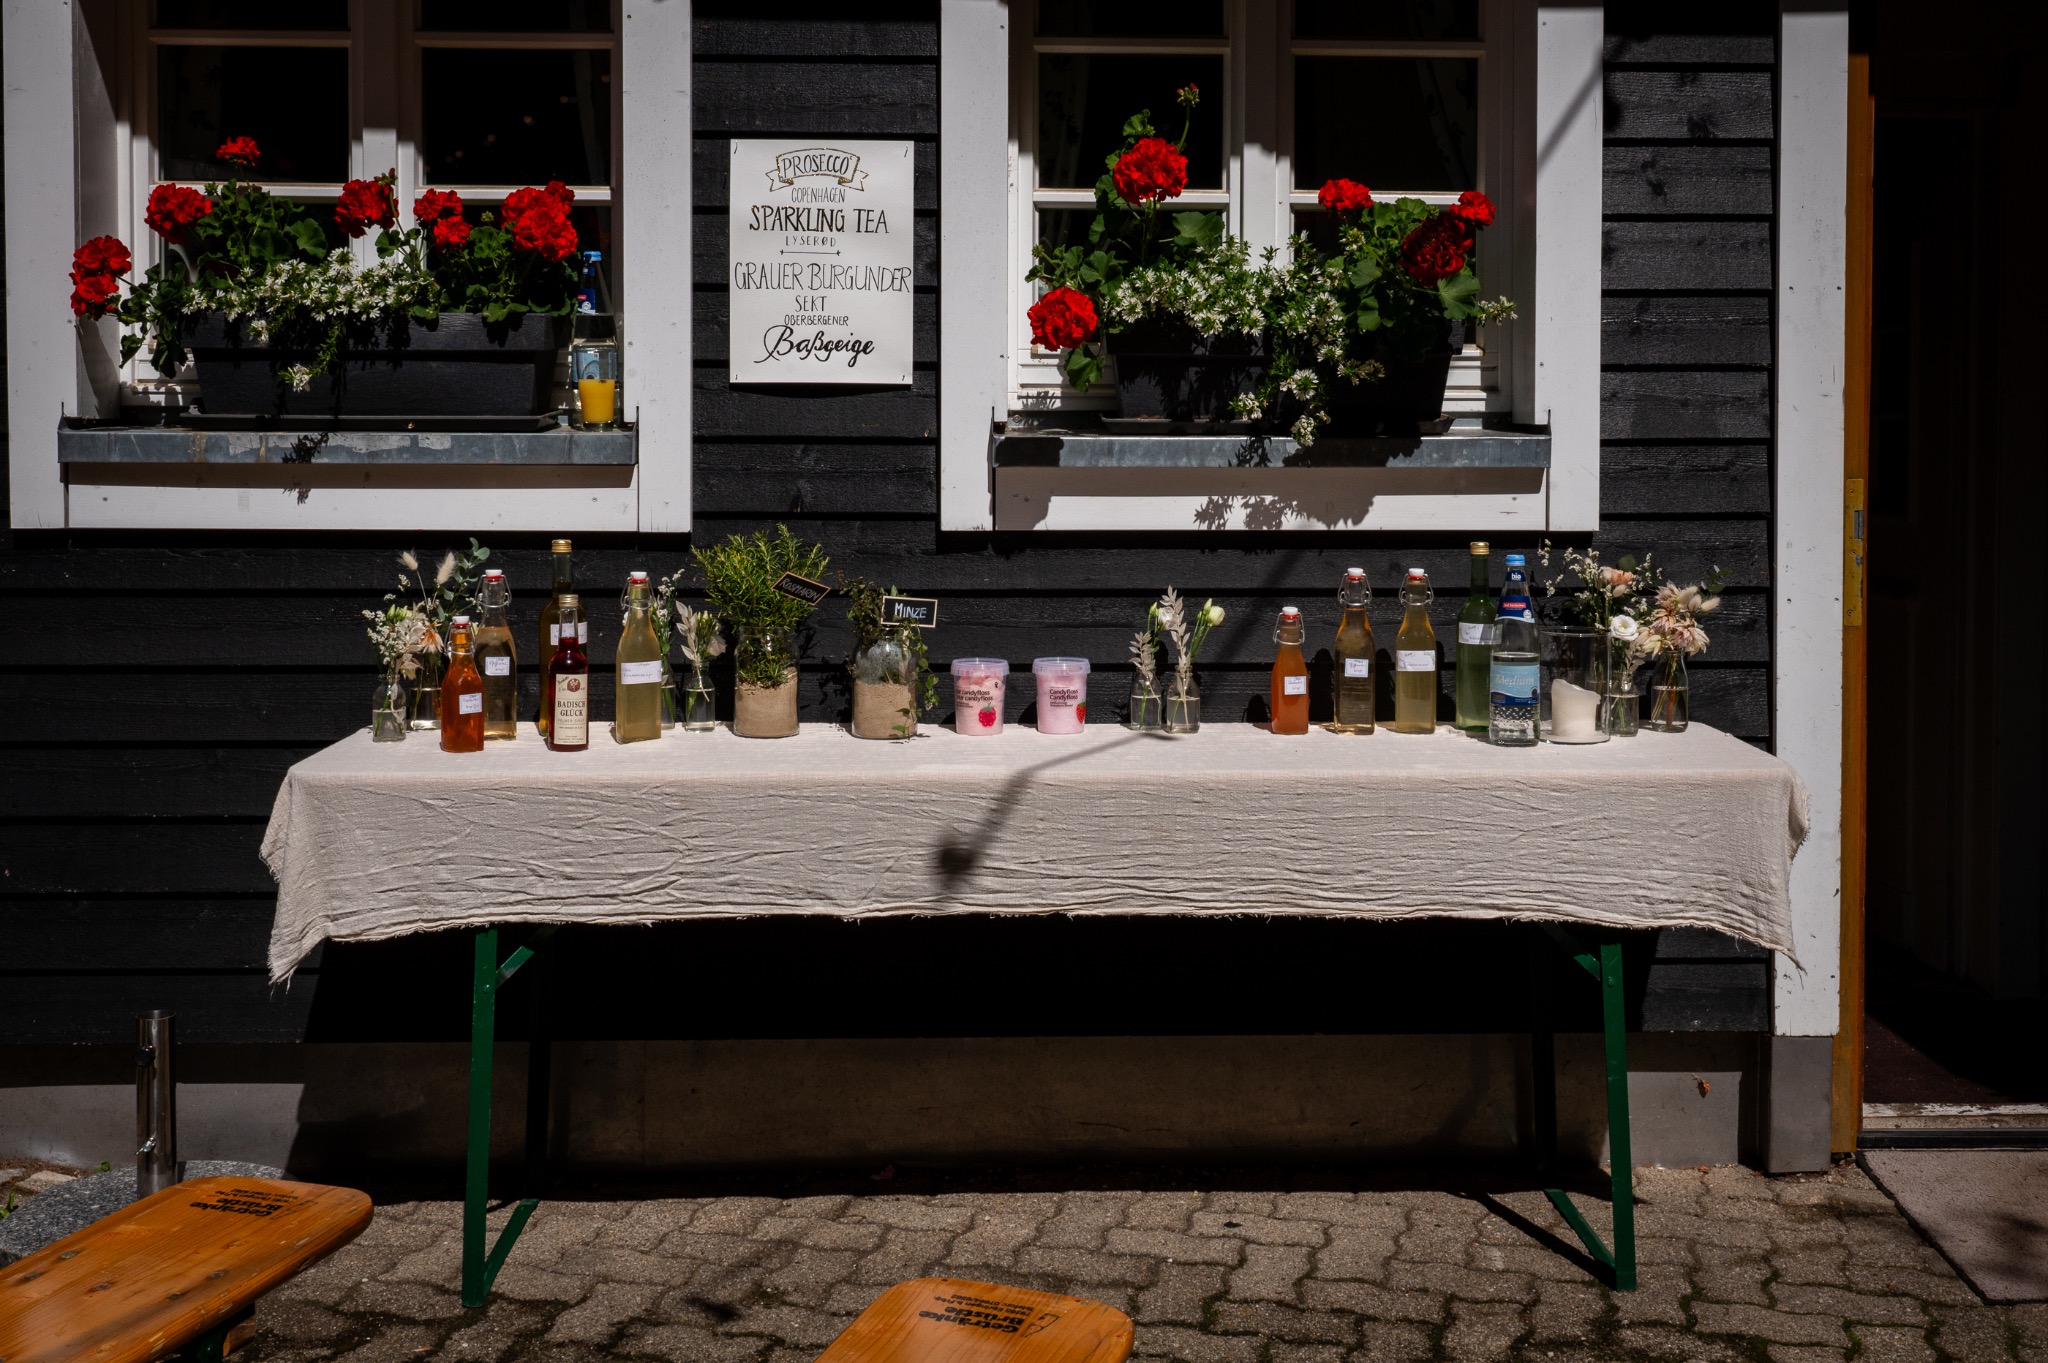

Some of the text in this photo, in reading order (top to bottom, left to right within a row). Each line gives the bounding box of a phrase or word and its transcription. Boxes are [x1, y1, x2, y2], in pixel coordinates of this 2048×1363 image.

[781, 154, 852, 178] PROSECCO
[791, 187, 846, 204] COPENHAGEN
[749, 205, 889, 233] SPARKLING TEA
[785, 235, 837, 247] LYSERØD
[734, 261, 912, 293] GRAUER BURGUNDER
[795, 295, 827, 312] SEKT
[784, 314, 849, 326] OBERBERGENER
[753, 324, 875, 368] Baßgeige
[1511, 572, 1522, 581] bio
[779, 577, 820, 601] ROSMARIN
[894, 601, 927, 619] MINZE
[1495, 674, 1535, 686] Medium
[962, 689, 990, 697] candyfloss
[1049, 688, 1078, 696] Candyfloss
[1049, 694, 1078, 702] Candyfloss
[557, 700, 586, 709] BADISCH
[560, 708, 583, 717] GLÜCK
[189, 1201, 273, 1218] Getränke
[216, 1198, 285, 1212] Brüstle
[919, 1310, 1020, 1333] Getränke
[944, 1306, 1025, 1326] Brüstle
